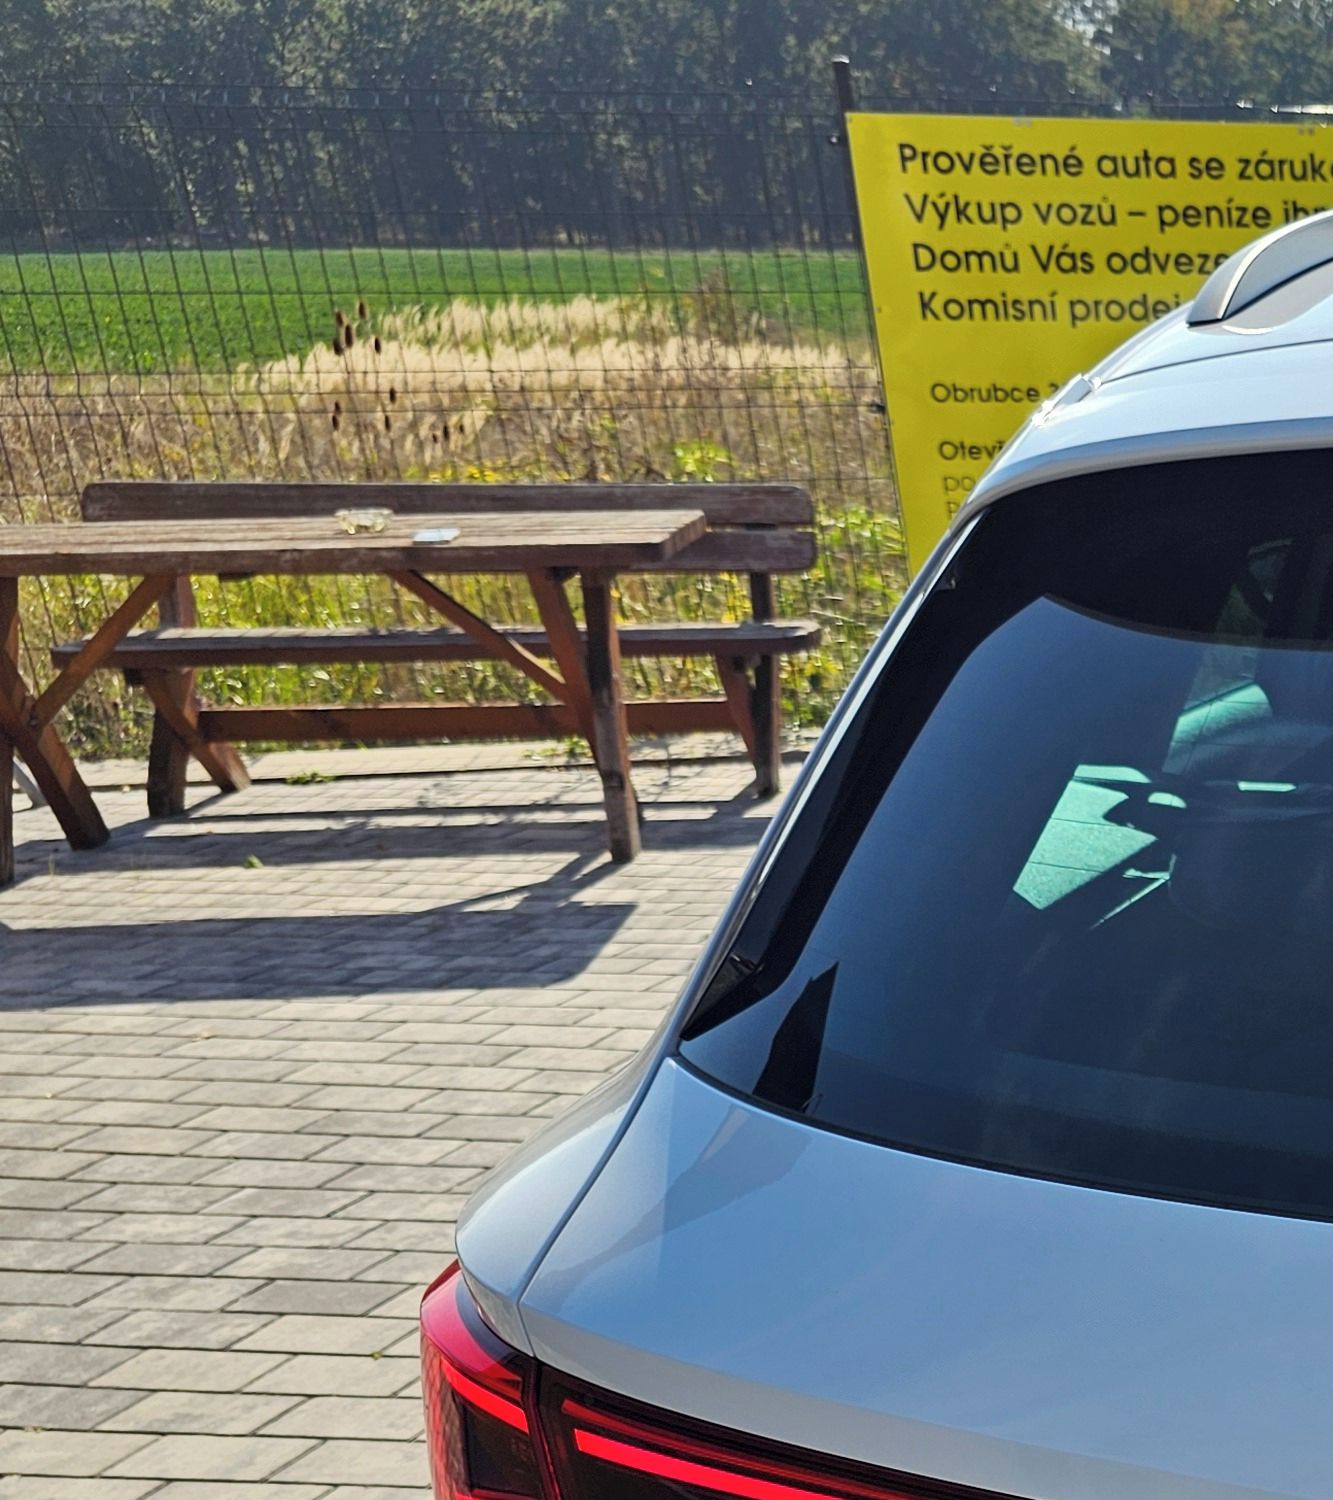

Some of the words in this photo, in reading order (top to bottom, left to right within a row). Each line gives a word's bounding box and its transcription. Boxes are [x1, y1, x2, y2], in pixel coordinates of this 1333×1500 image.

[898, 143, 1085, 177] Prověřené
[1096, 149, 1177, 180] auta
[1188, 158, 1226, 180] se
[903, 192, 1023, 231] Výkup
[1033, 196, 1117, 227] vozů
[1157, 198, 1272, 234] peníze
[912, 242, 1021, 274] Domů
[1029, 242, 1096, 275] Vás
[918, 290, 1058, 323] Komisní
[930, 383, 1041, 404] Obrubce
